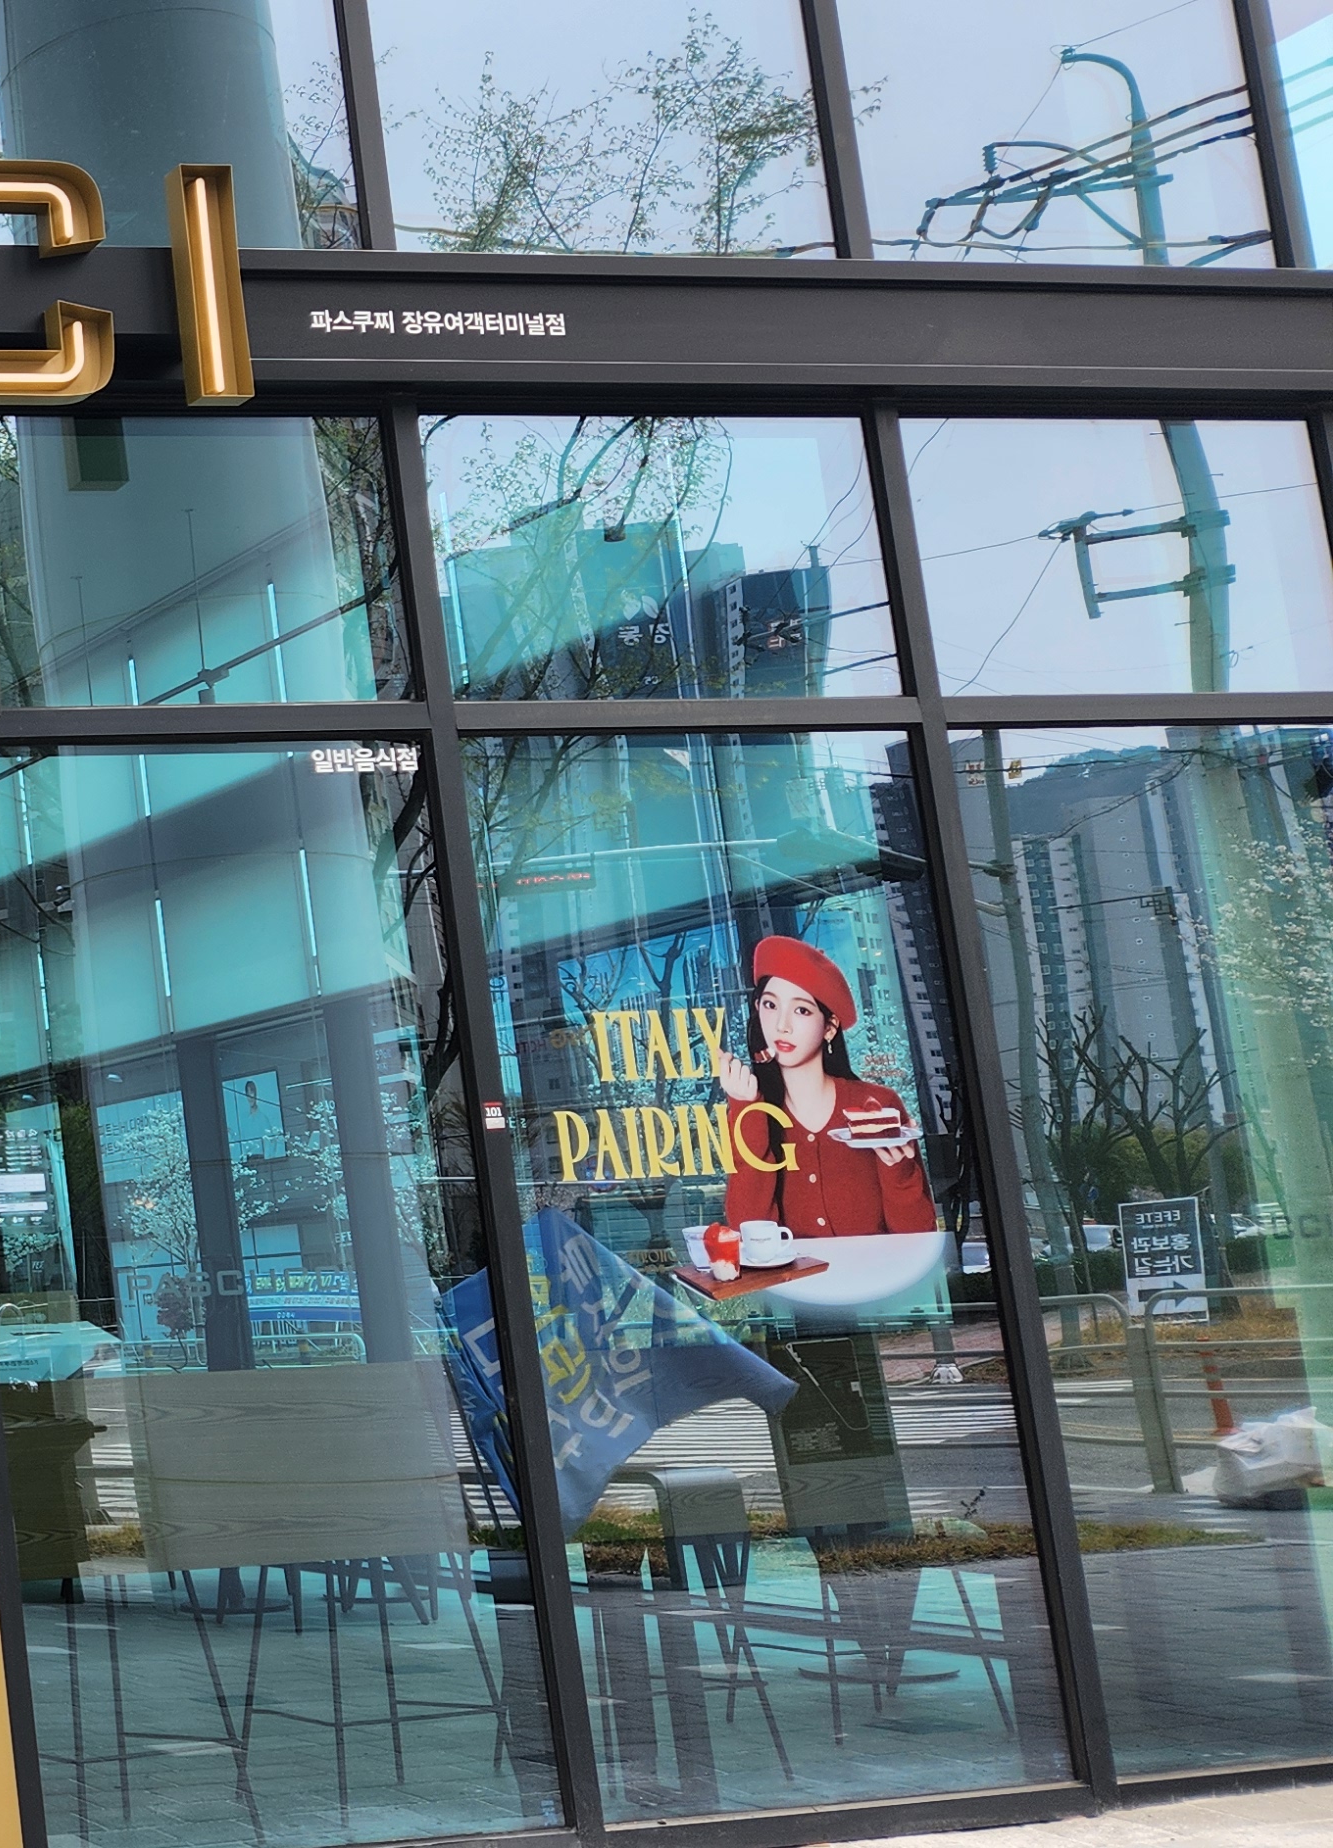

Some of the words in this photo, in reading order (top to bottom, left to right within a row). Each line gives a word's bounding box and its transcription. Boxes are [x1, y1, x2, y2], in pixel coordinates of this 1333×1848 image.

[309, 309, 395, 334] 파스쿠찌
[401, 310, 567, 337] 장유여객터미널점
[311, 747, 419, 773] 일반음식점
[591, 1007, 726, 1082] ITALY
[484, 1106, 503, 1117] 101
[553, 1102, 801, 1182] PAIRING
